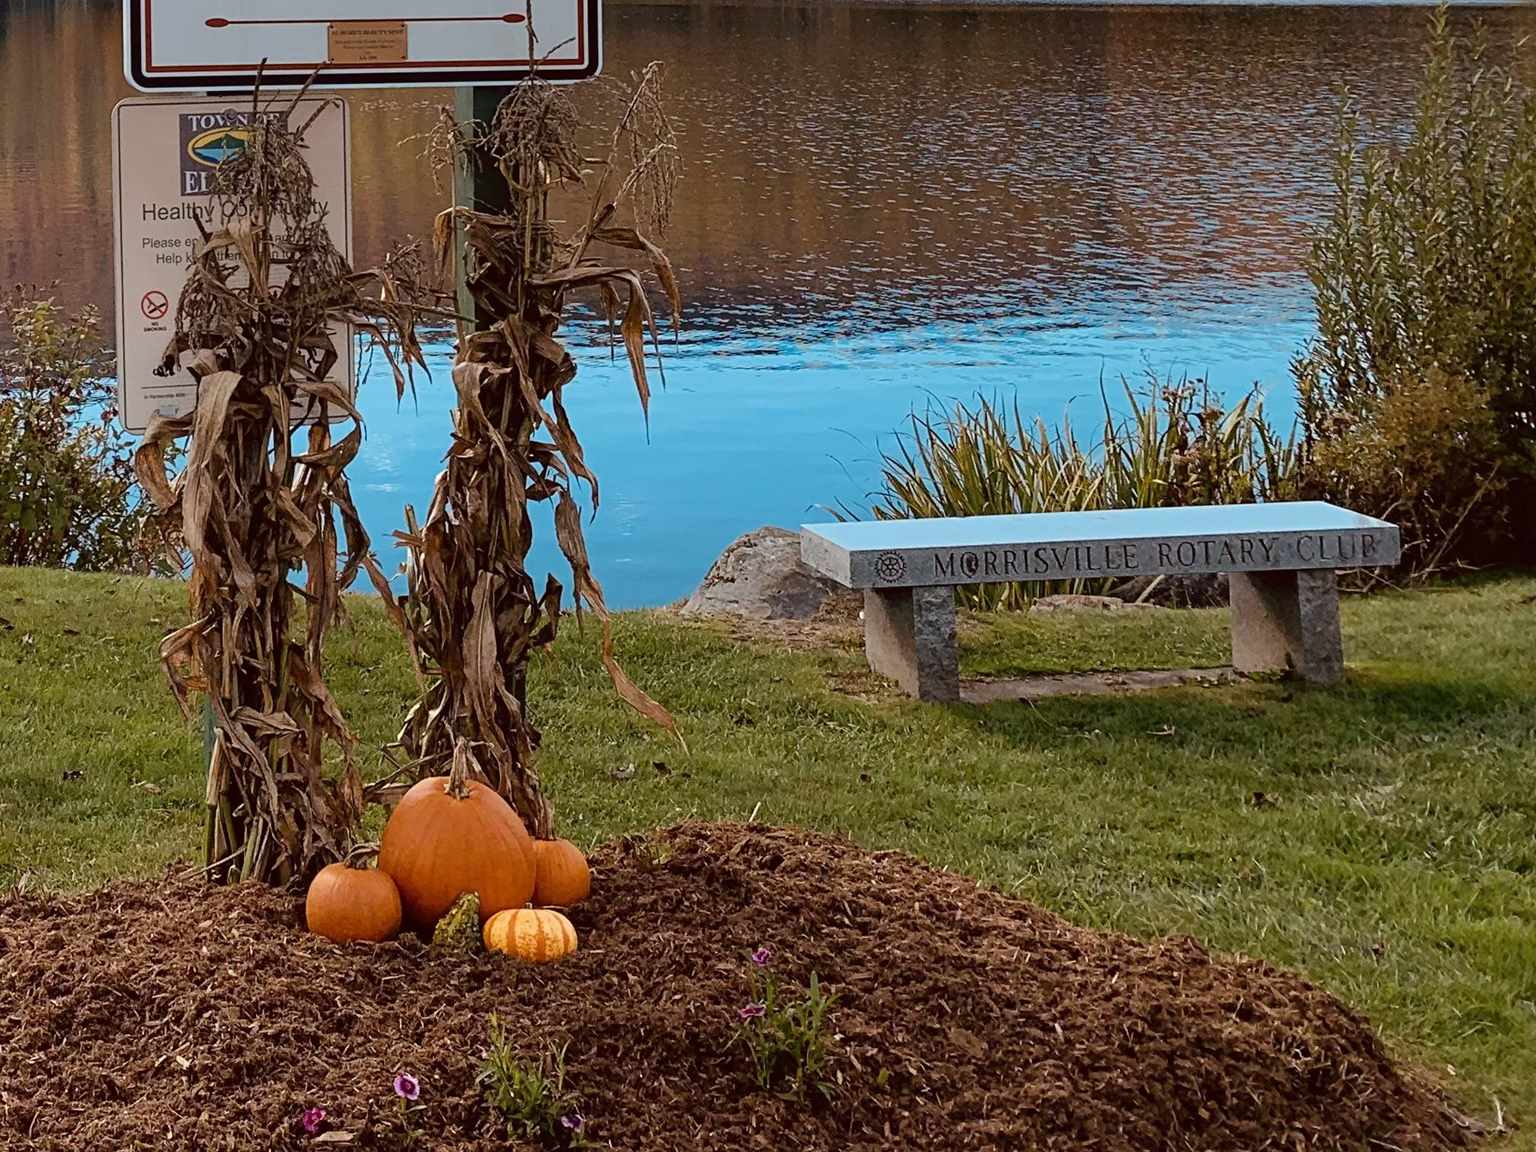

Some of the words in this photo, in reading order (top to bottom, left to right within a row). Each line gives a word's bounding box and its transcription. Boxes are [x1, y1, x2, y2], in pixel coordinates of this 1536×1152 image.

[142, 203, 215, 223] Healthy
[142, 237, 181, 249] Please
[156, 253, 182, 265] Help
[934, 545, 1139, 578] MORRISVILLE
[1158, 538, 1280, 567] ROTARY
[1296, 535, 1377, 562] CLUB
